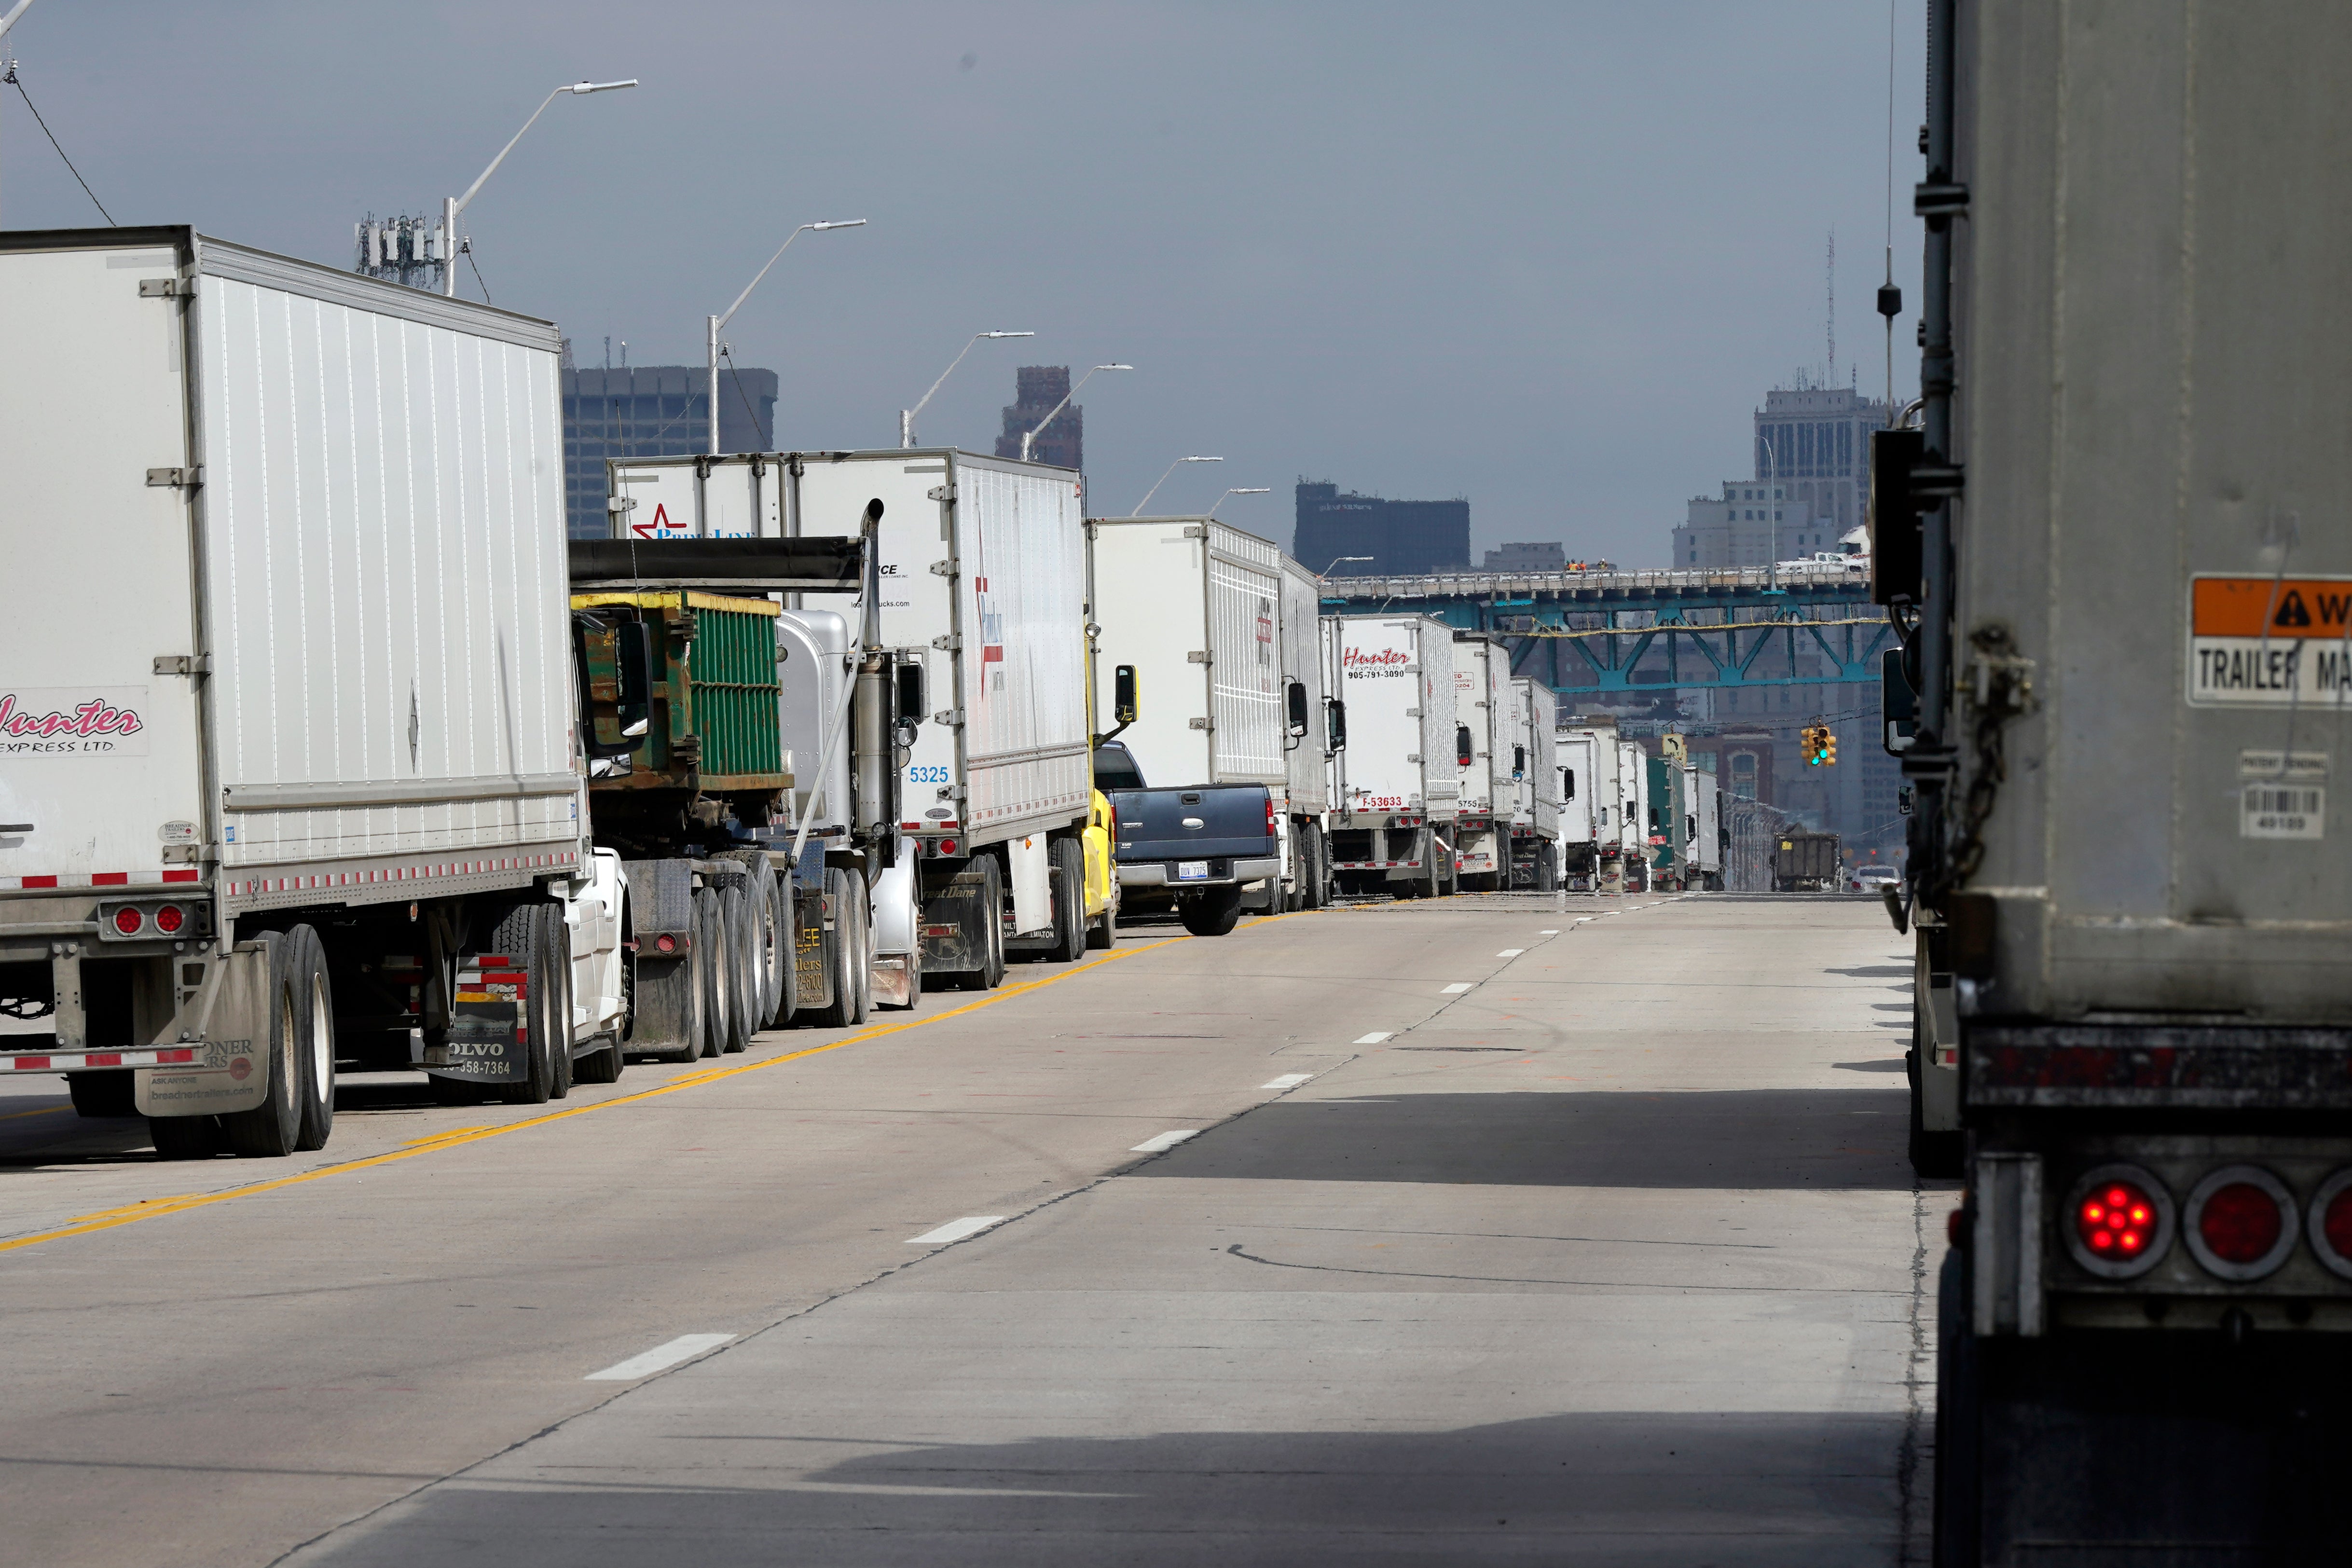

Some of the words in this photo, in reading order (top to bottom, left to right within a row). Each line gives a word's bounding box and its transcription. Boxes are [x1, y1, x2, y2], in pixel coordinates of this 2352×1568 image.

[1343, 646, 1411, 669] Hunter
[1348, 670, 1404, 679] 905-791-3090
[2316, 651, 2352, 690] MA
[0, 742, 76, 753] EXPRESS
[84, 742, 116, 751] LTD.
[910, 767, 949, 783] 5325
[1363, 797, 1402, 807] F-53633
[924, 888, 947, 898] reat
[946, 886, 977, 898] Dane
[796, 958, 822, 972] ilers
[204, 1039, 254, 1057] DNER
[448, 1043, 504, 1056] OLVO
[151, 1087, 253, 1100] breadnertrailers.com
